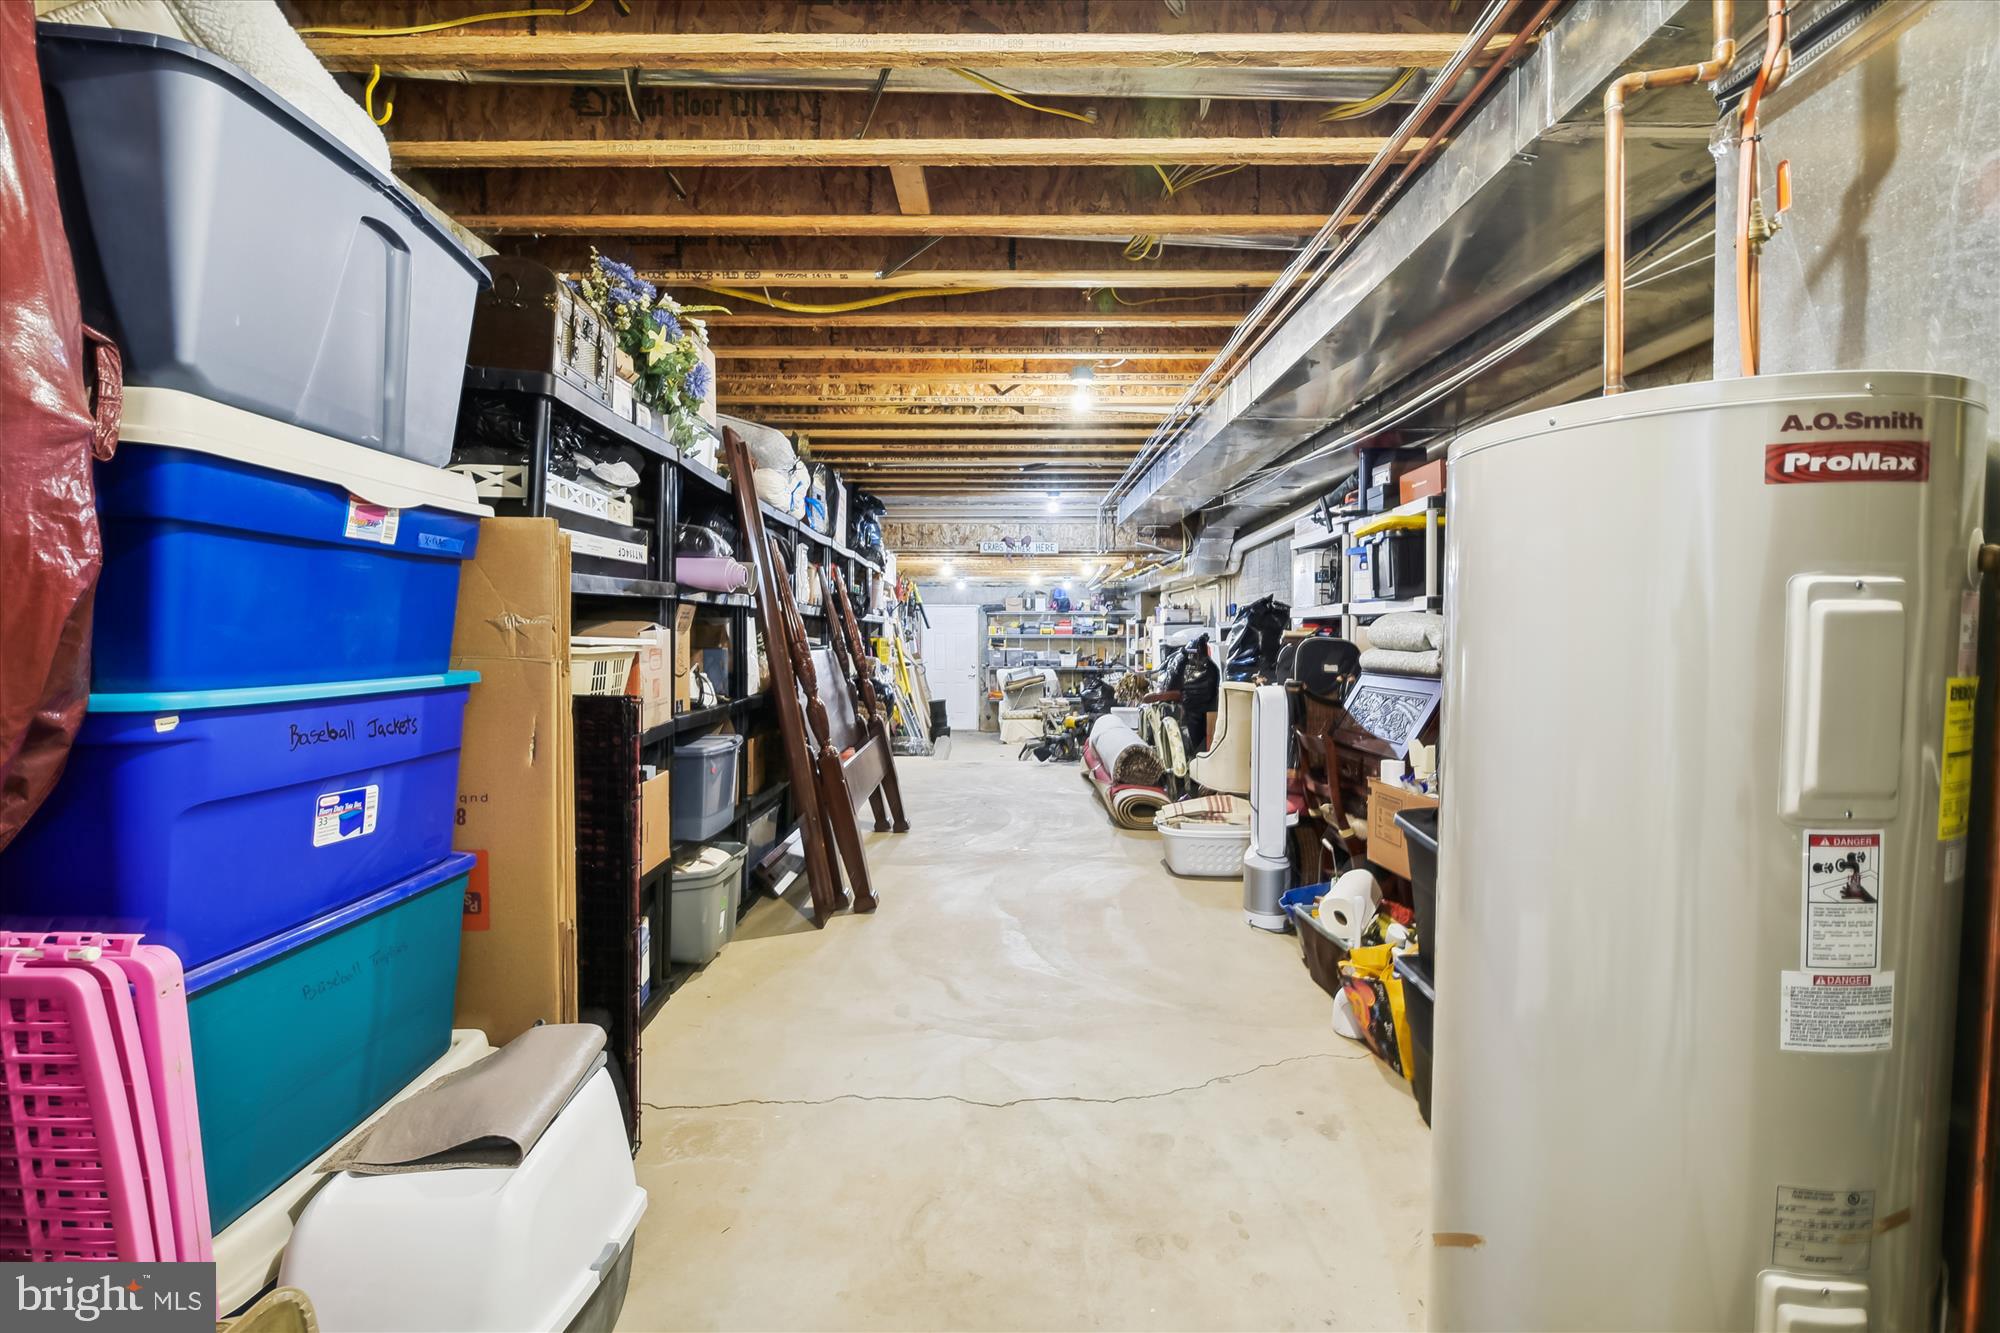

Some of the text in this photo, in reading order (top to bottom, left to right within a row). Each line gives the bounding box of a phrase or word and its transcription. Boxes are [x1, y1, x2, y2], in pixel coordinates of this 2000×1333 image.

[672, 89, 723, 117] Floor
[1780, 411, 1924, 432] A.O.Smith
[1783, 452, 1916, 473] ProMax
[1035, 543, 1056, 552] HERE
[289, 715, 418, 751] Baseball Jackets
[1833, 838, 1872, 846] DANGER
[1827, 976, 1870, 985] DANGER
